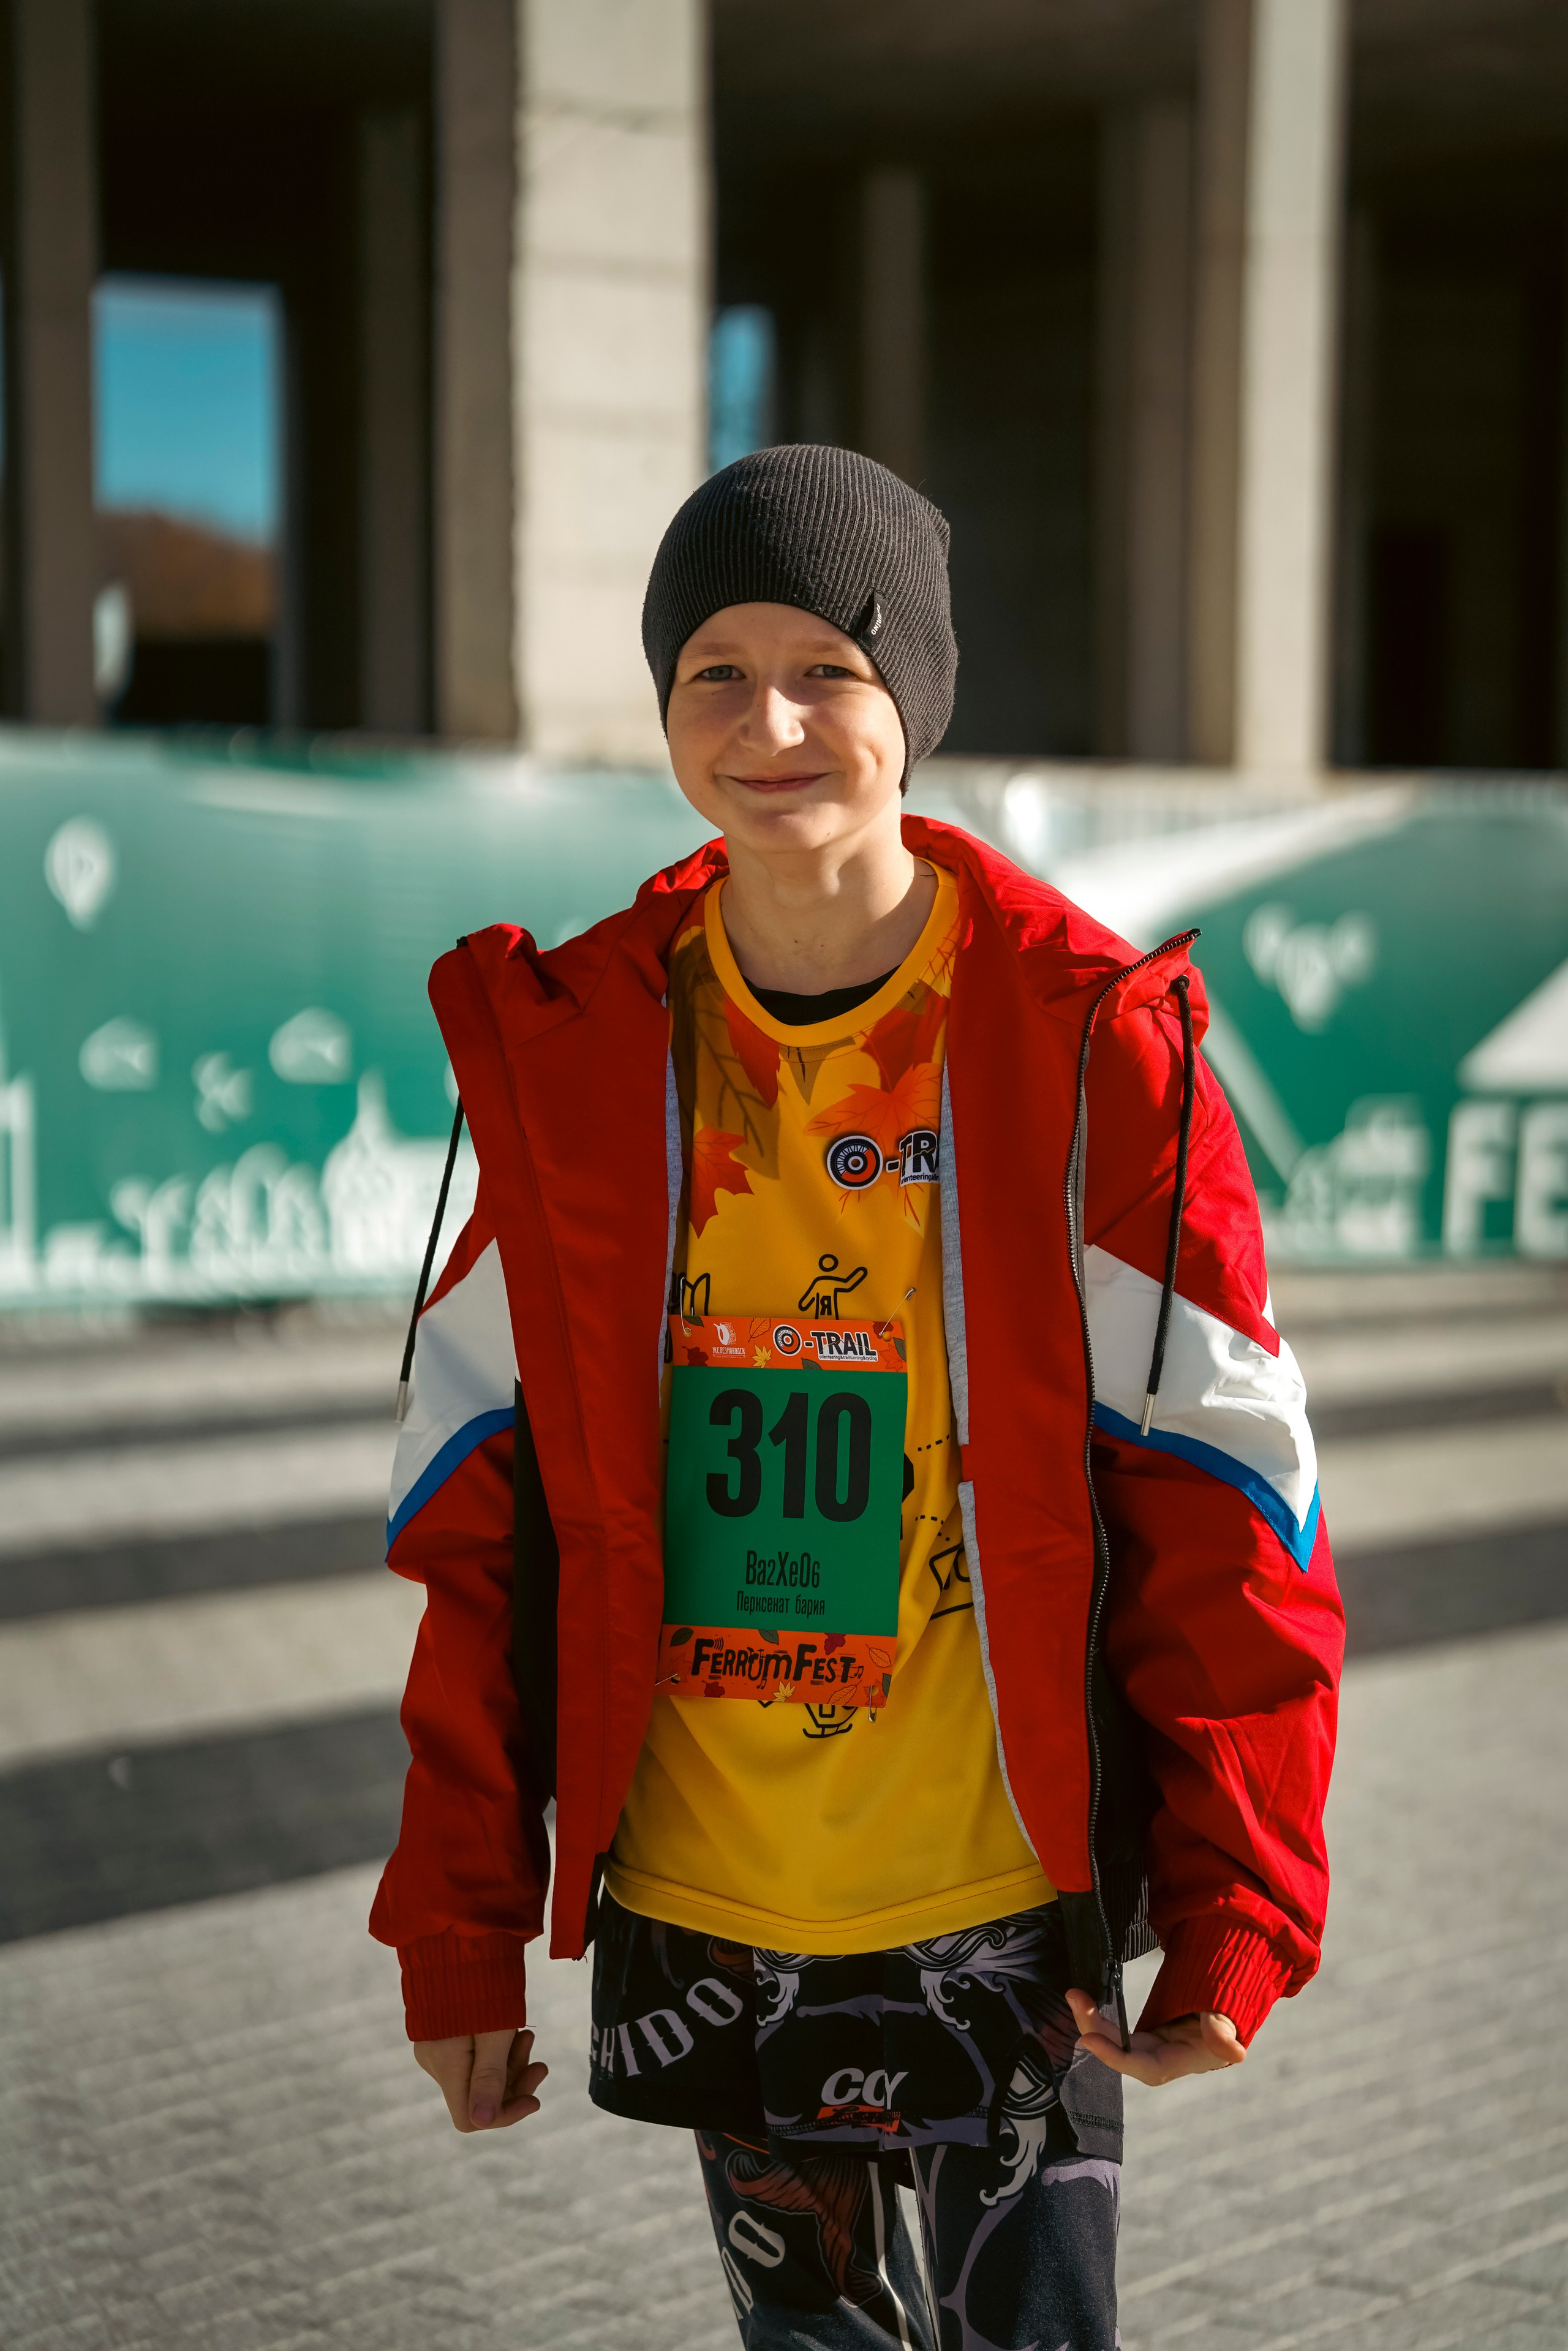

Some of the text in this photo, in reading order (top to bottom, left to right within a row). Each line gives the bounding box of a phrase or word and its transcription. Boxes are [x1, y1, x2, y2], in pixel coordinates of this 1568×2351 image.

[829, 1131, 940, 1188] O-TR
[706, 1389, 872, 1522] 310
[736, 1591, 825, 1618] Перксенат бария
